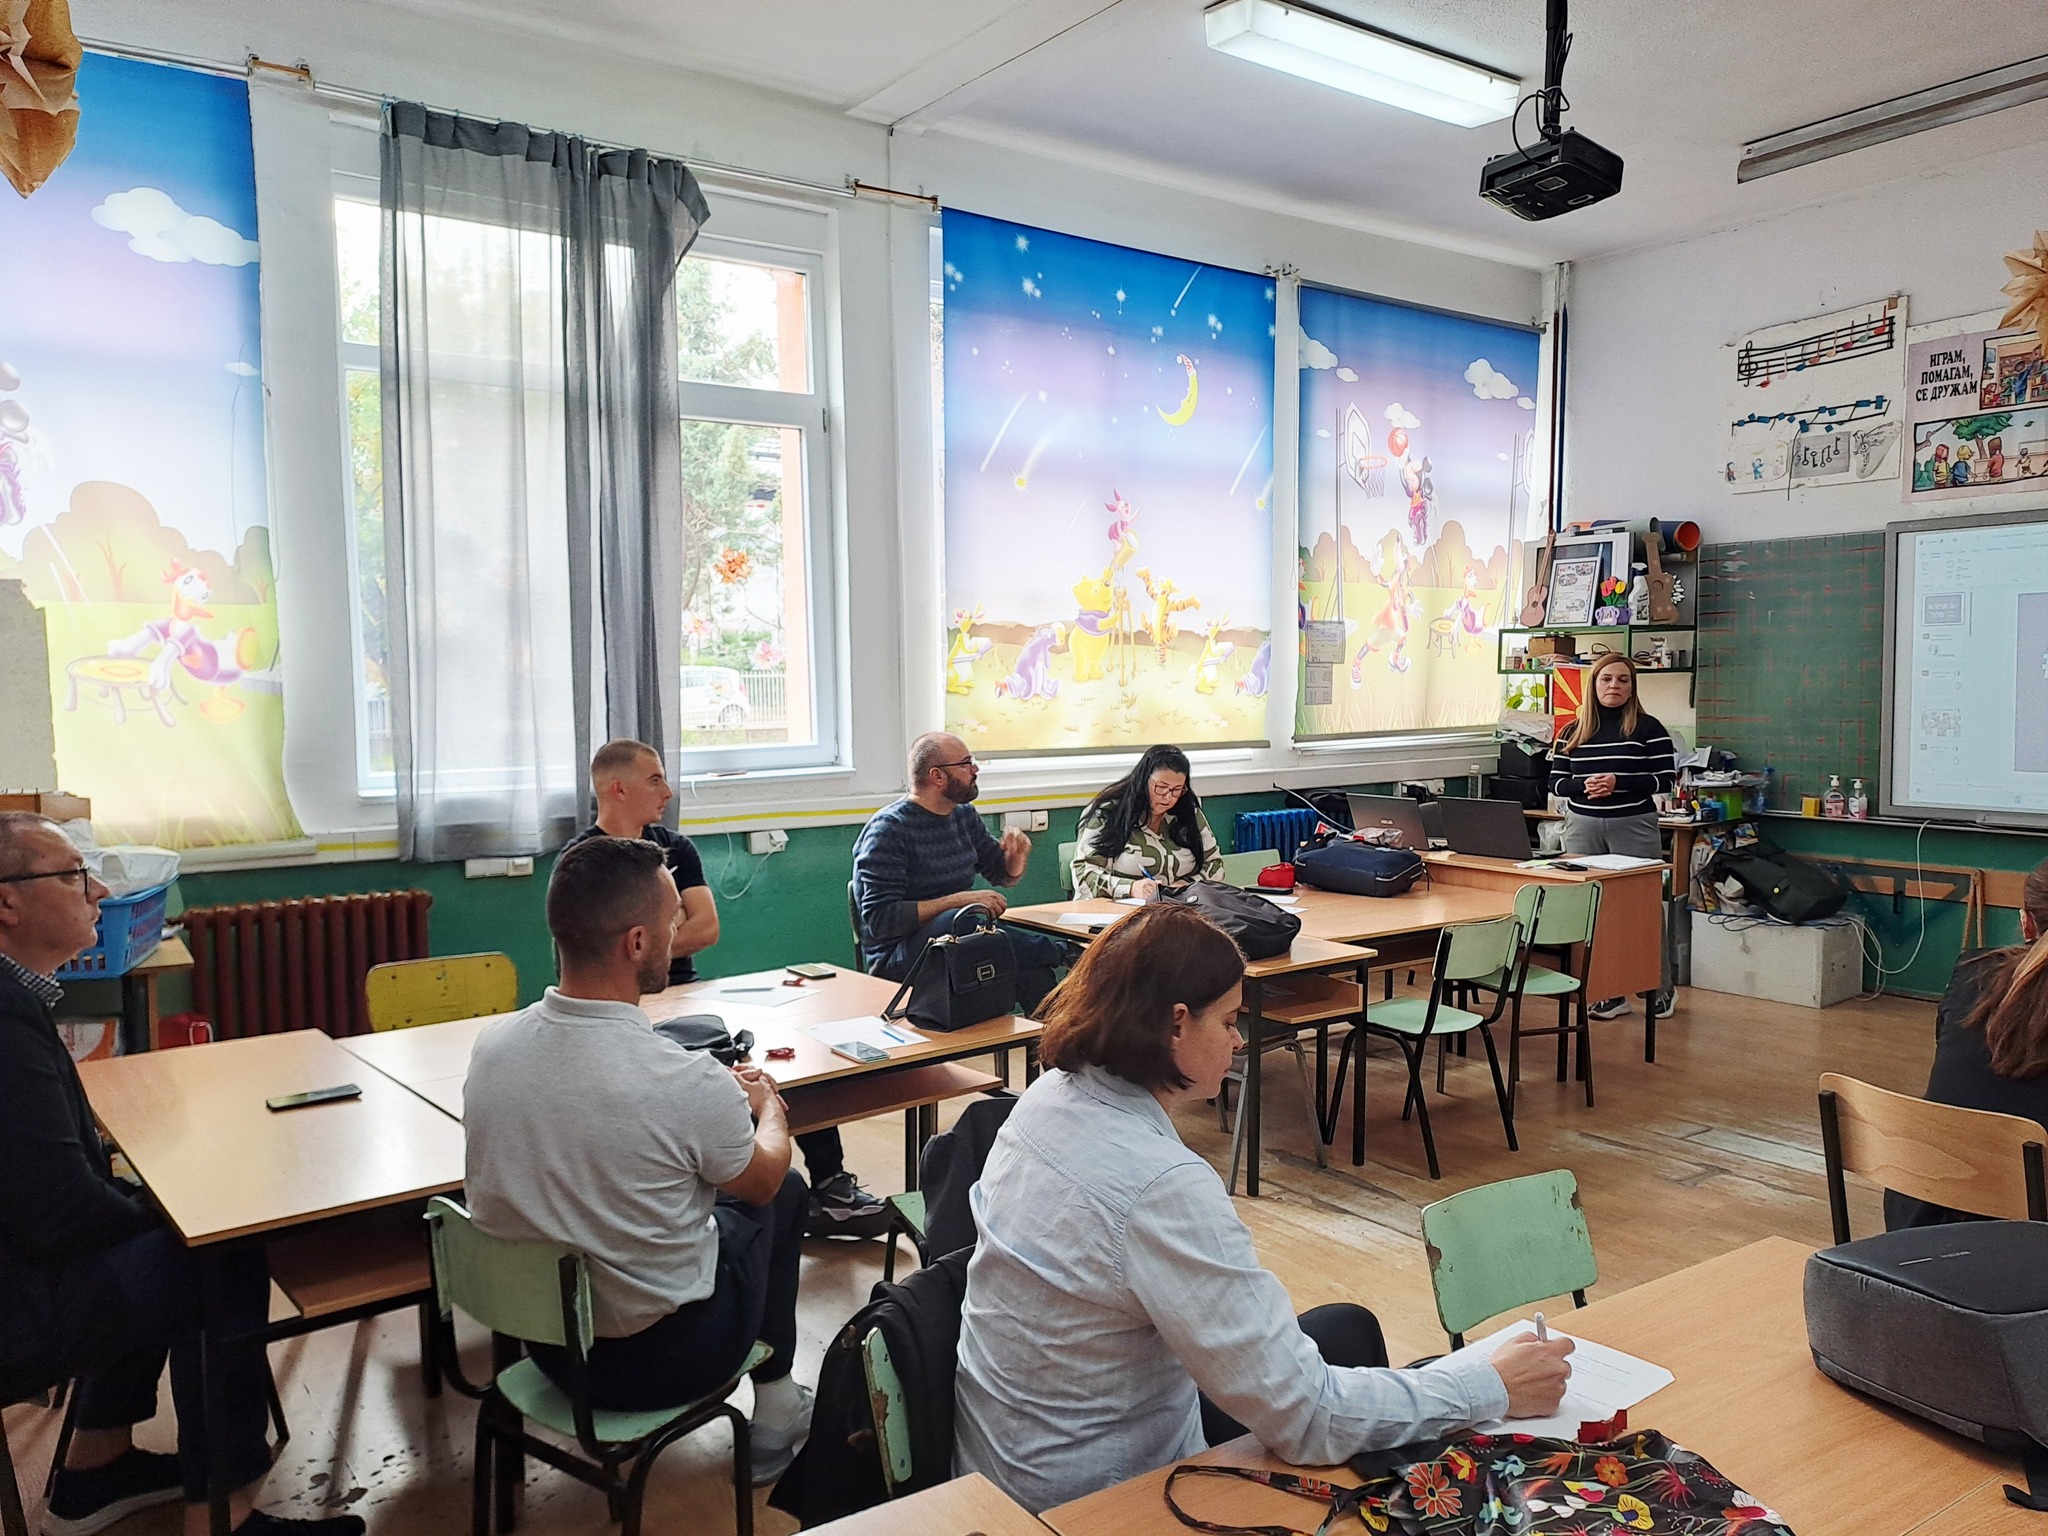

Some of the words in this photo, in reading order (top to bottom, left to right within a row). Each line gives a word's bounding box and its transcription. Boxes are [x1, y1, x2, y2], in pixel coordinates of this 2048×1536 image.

[1930, 349, 1965, 367] ИГРАМ,
[1921, 365, 1973, 385] ПОМАГАМ,
[1916, 388, 1928, 402] СЕ
[1930, 381, 1978, 402] ДРУЖАМ
